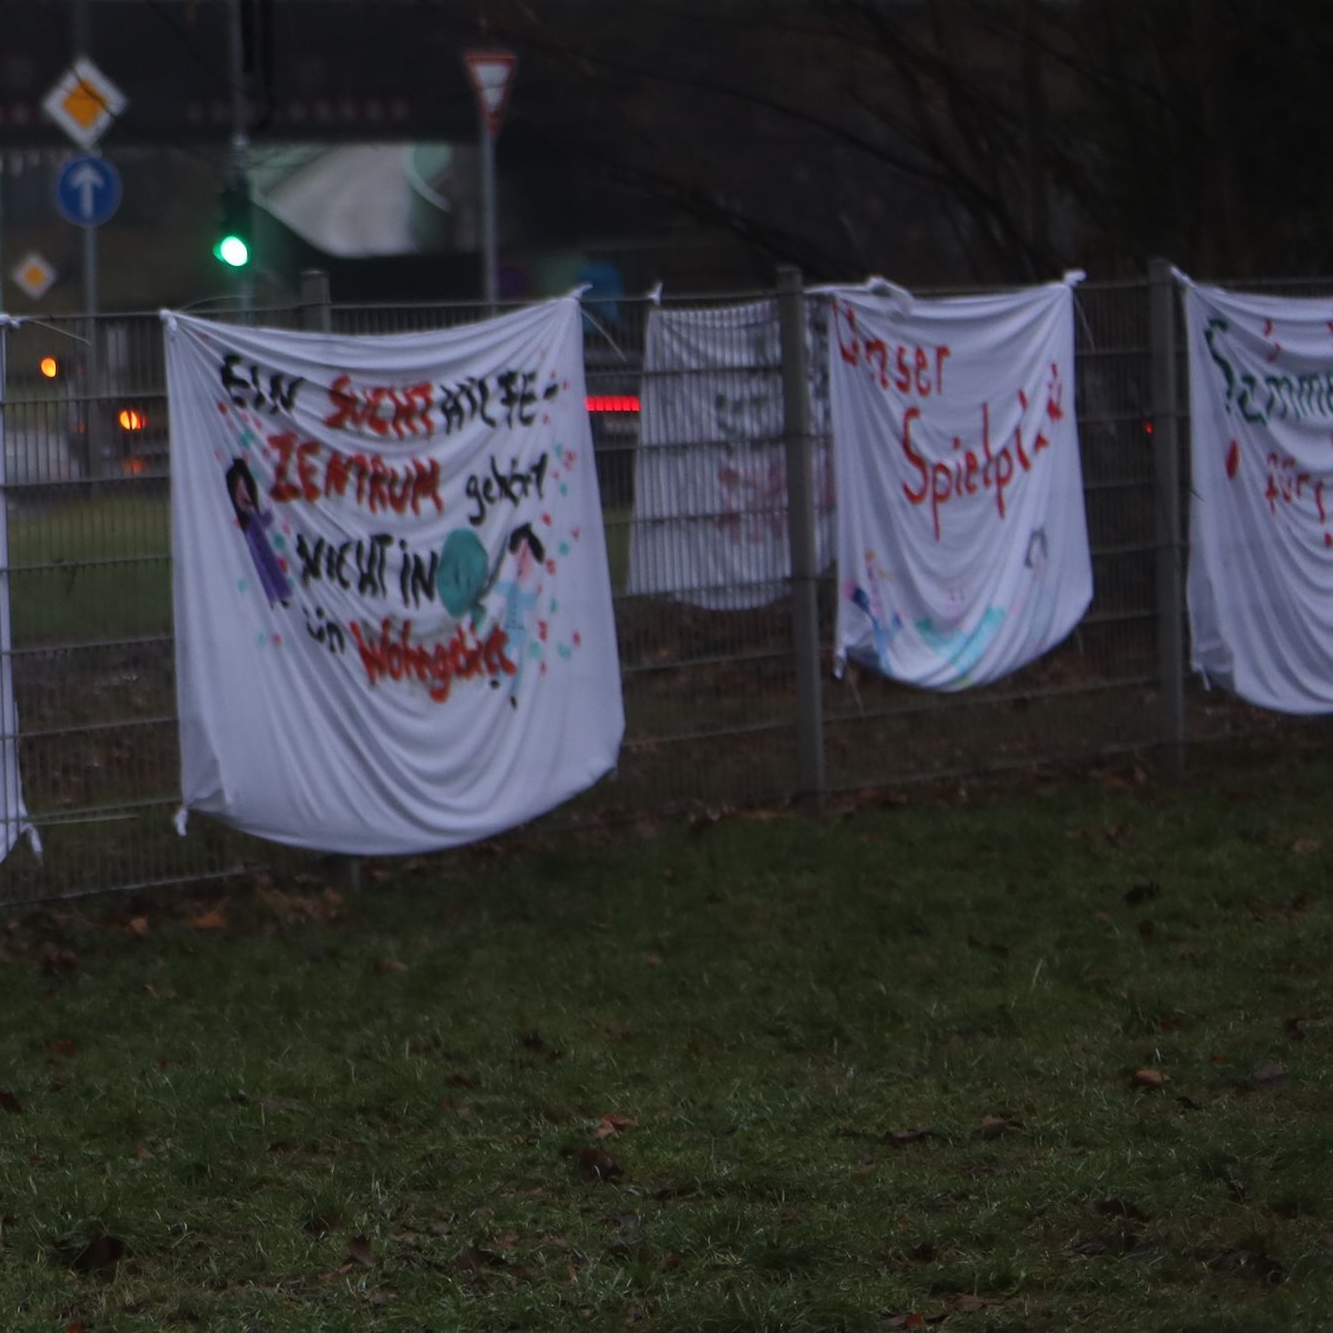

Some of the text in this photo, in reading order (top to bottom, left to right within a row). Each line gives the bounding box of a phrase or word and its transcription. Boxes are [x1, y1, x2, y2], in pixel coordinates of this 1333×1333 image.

[830, 296, 952, 397] Unser
[267, 432, 445, 516] ZENTRUM
[902, 363, 1063, 541] Spielpl
[296, 534, 394, 598] NICHT
